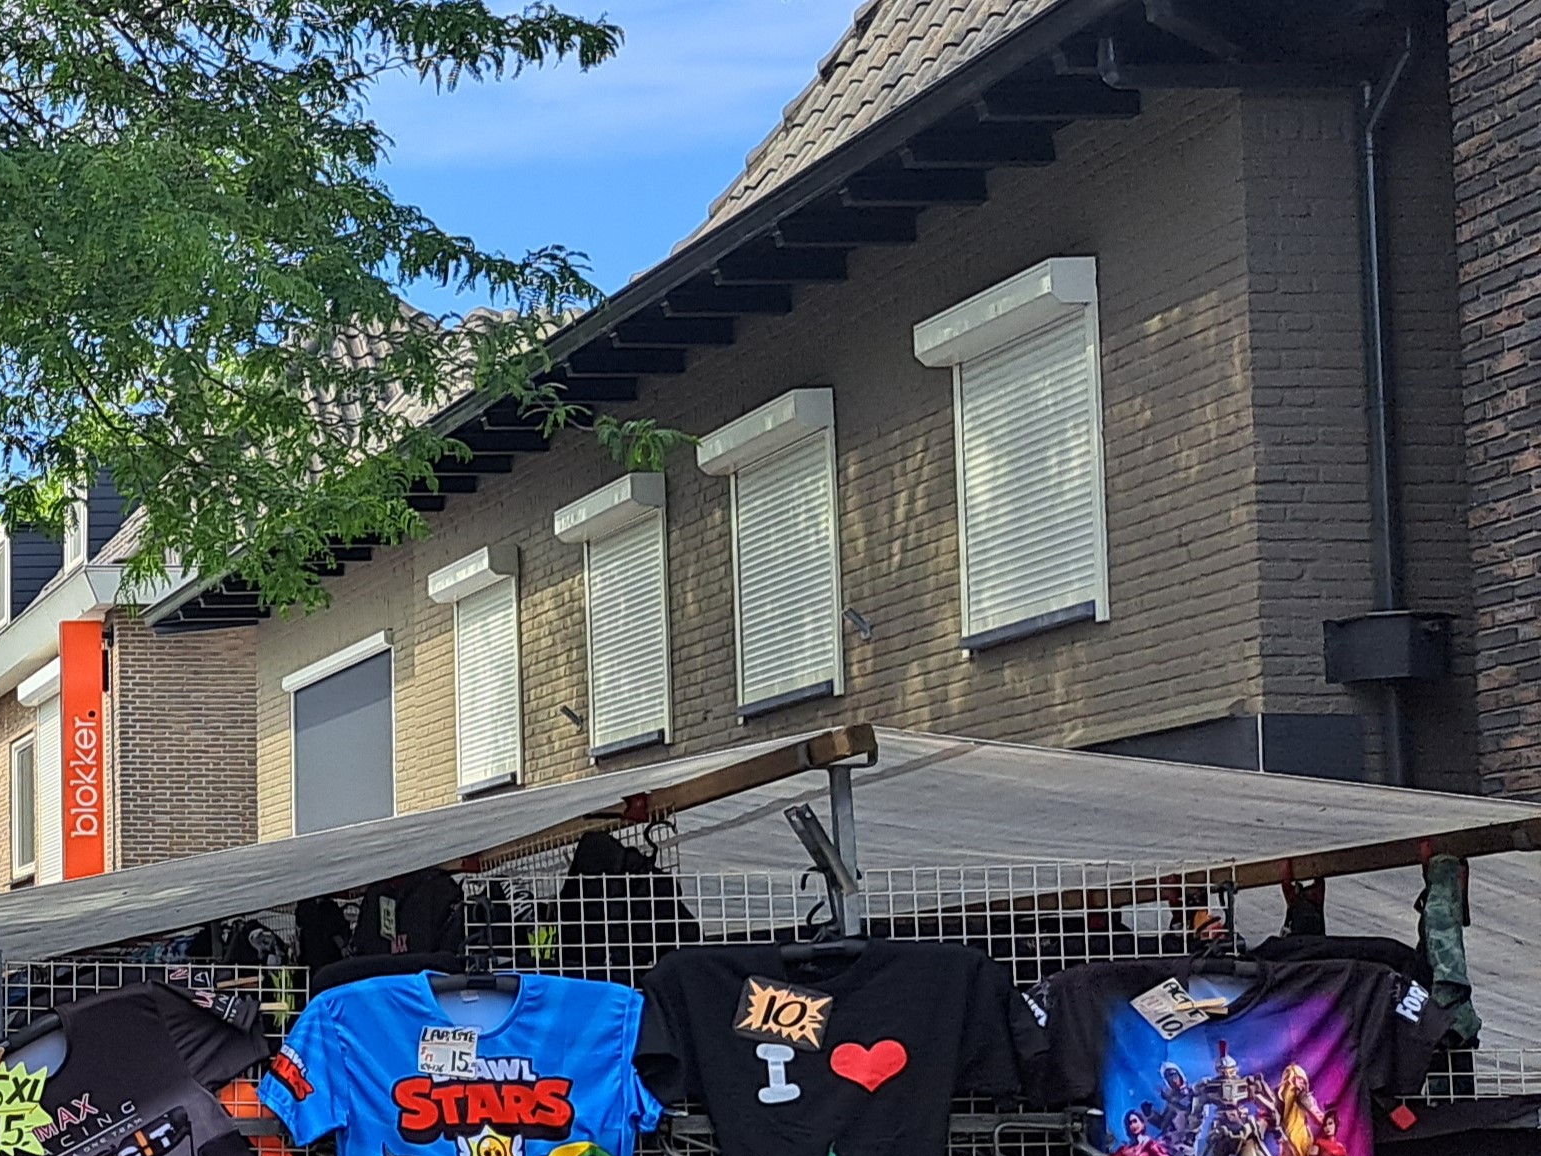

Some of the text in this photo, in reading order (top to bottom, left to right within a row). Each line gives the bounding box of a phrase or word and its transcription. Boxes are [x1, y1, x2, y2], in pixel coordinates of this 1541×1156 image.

[430, 1057, 537, 1083] AWL
[755, 1042, 801, 1103] I
[31, 1092, 99, 1142] MAX
[393, 1077, 573, 1133] STARS
